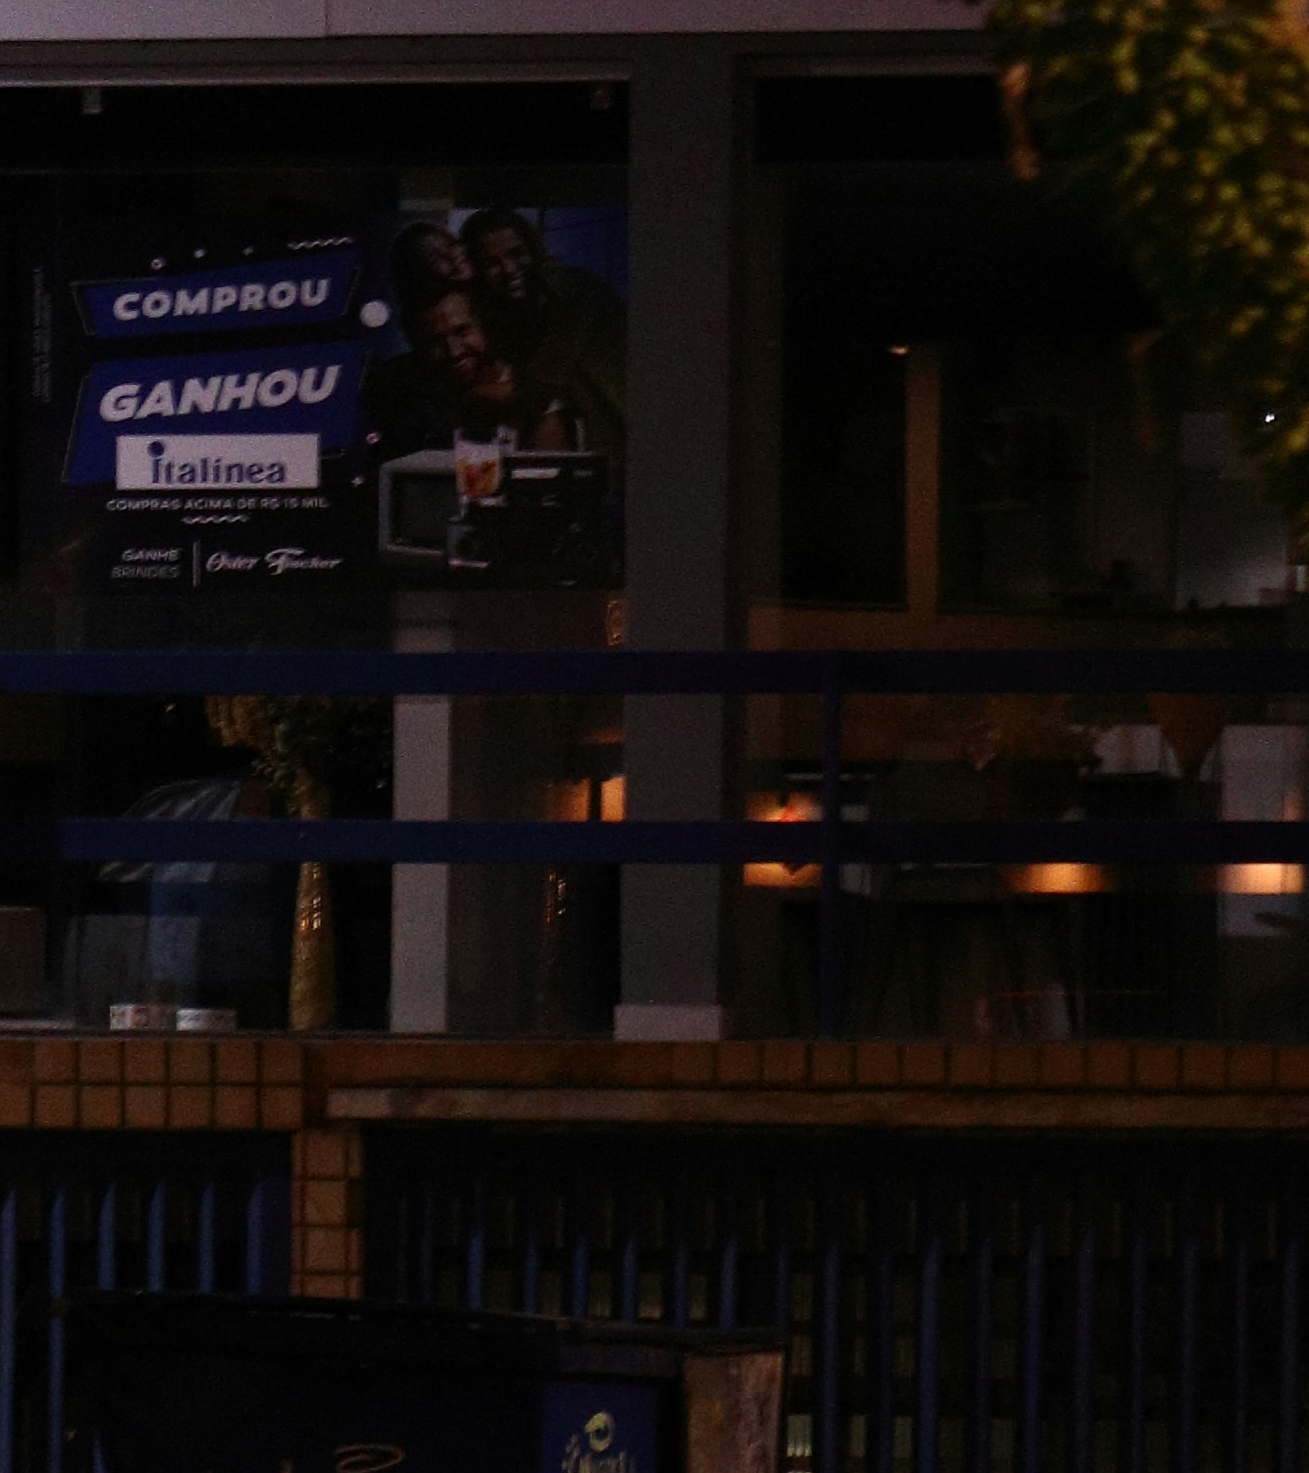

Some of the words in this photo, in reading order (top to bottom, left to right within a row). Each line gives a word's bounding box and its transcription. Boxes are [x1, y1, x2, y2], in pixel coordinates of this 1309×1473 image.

[112, 277, 333, 323] COMPROU
[98, 364, 344, 423] GANHOU
[106, 497, 182, 513] COMPRAS
